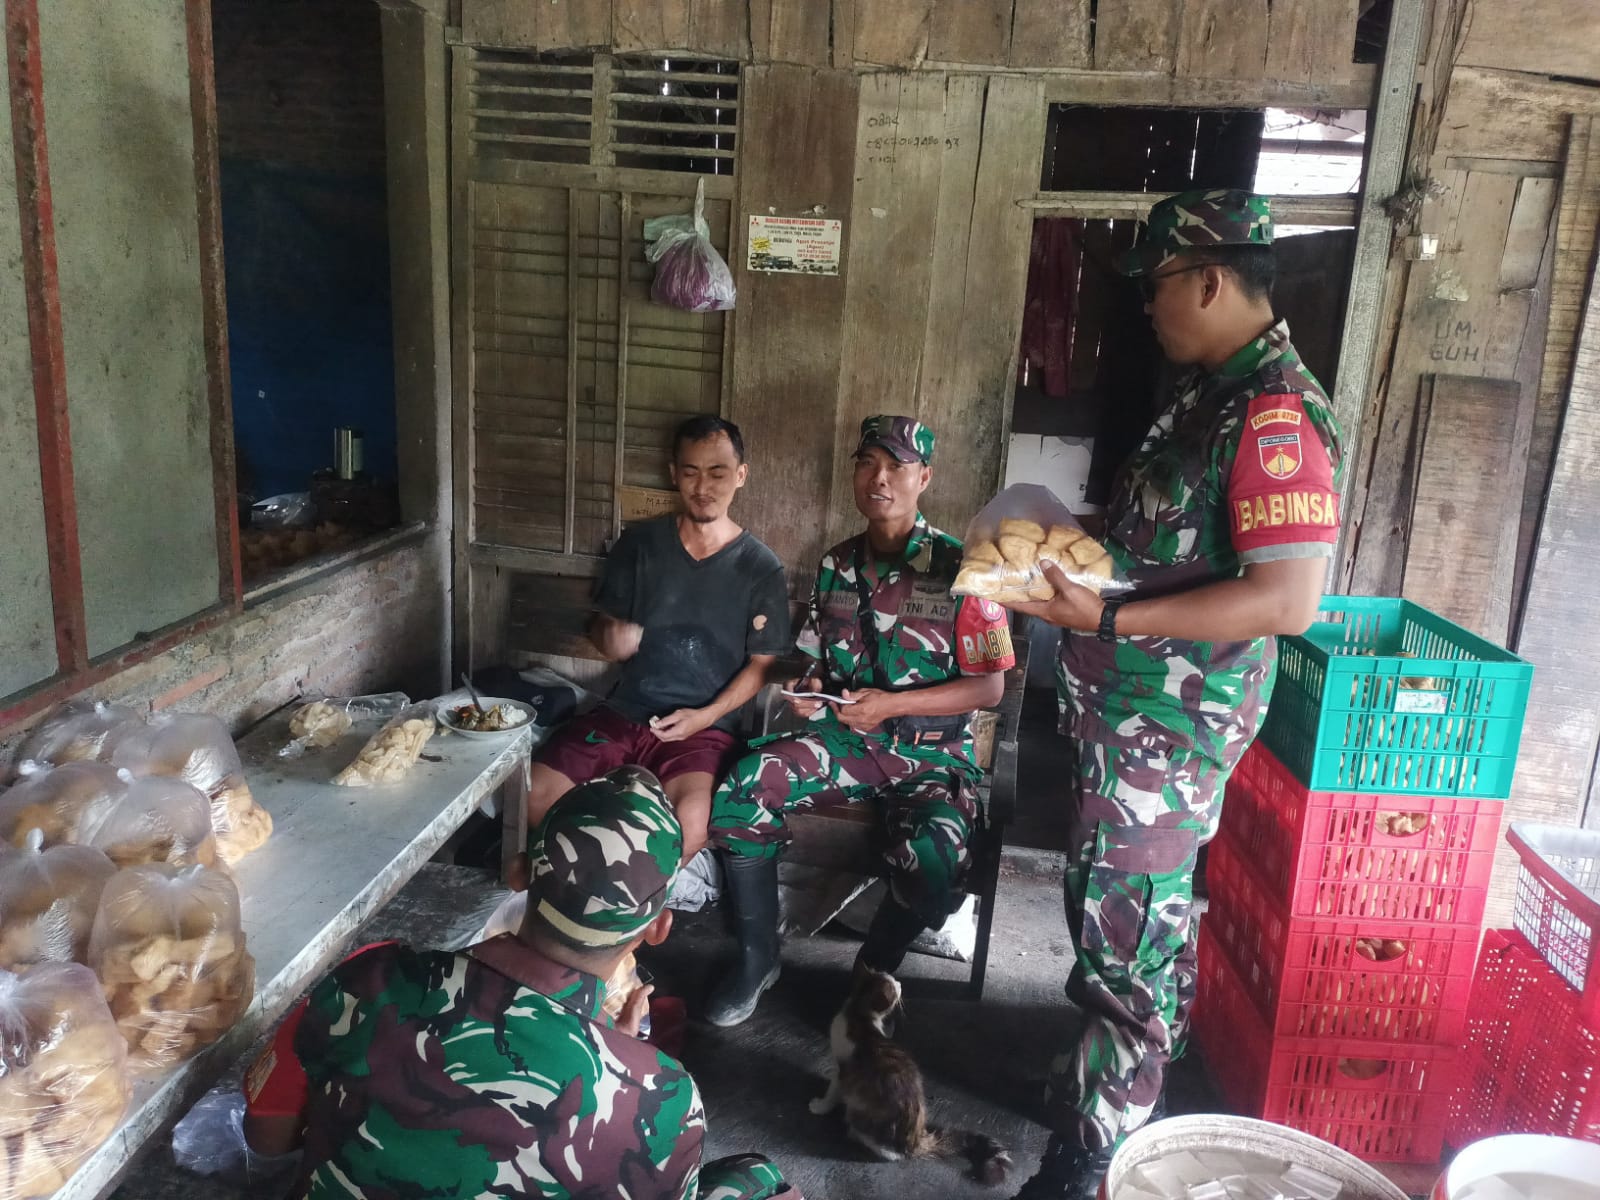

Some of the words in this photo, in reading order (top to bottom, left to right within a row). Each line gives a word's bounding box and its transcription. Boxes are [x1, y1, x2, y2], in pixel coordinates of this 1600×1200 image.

[1253, 411, 1279, 427] KODIM
[1238, 491, 1336, 532] BABINSA
[904, 601, 924, 615] TNI
[930, 604, 948, 617] AD
